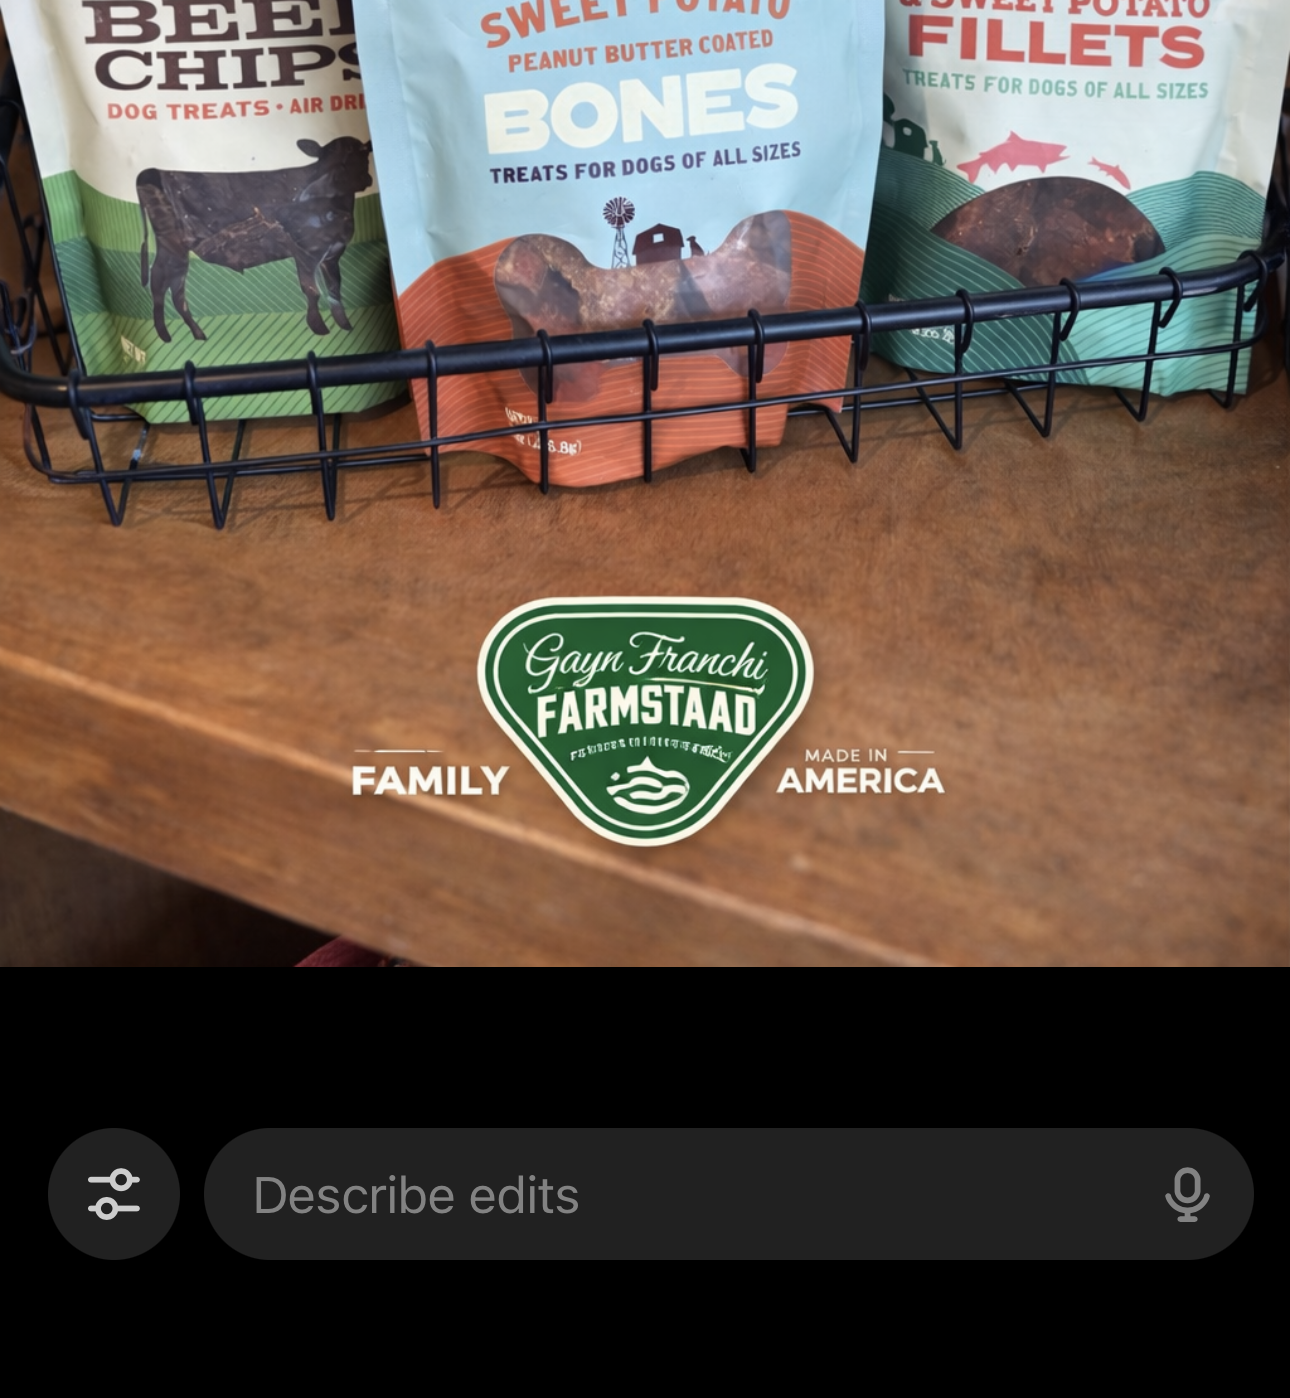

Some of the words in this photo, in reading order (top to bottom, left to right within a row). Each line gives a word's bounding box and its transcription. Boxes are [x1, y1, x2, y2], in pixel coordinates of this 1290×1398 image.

[508, 48, 597, 73] PEANUT
[605, 36, 693, 64] BUTTER
[699, 29, 773, 54] COATED
[908, 14, 1205, 69] FILLETS
[95, 42, 361, 91] CHIPS
[903, 69, 975, 90] TREATS
[983, 76, 1022, 95] FOR
[1029, 79, 1078, 97] DOGS
[1084, 81, 1107, 98] OF
[1114, 83, 1150, 99] ALL
[1157, 83, 1208, 99] SIZES
[107, 104, 157, 121] DOG
[166, 101, 269, 120] TREATS
[290, 98, 323, 114] AIR
[330, 93, 366, 111] DRI
[484, 63, 798, 155] BONES
[490, 165, 568, 184] TREATS
[574, 162, 616, 180] FOR
[622, 156, 676, 177] DOGS
[682, 151, 706, 169] OF
[712, 148, 747, 167] ALL
[752, 141, 801, 163] SIZES
[253, 1175, 456, 1215] Describe
[470, 1175, 580, 1215] edits
